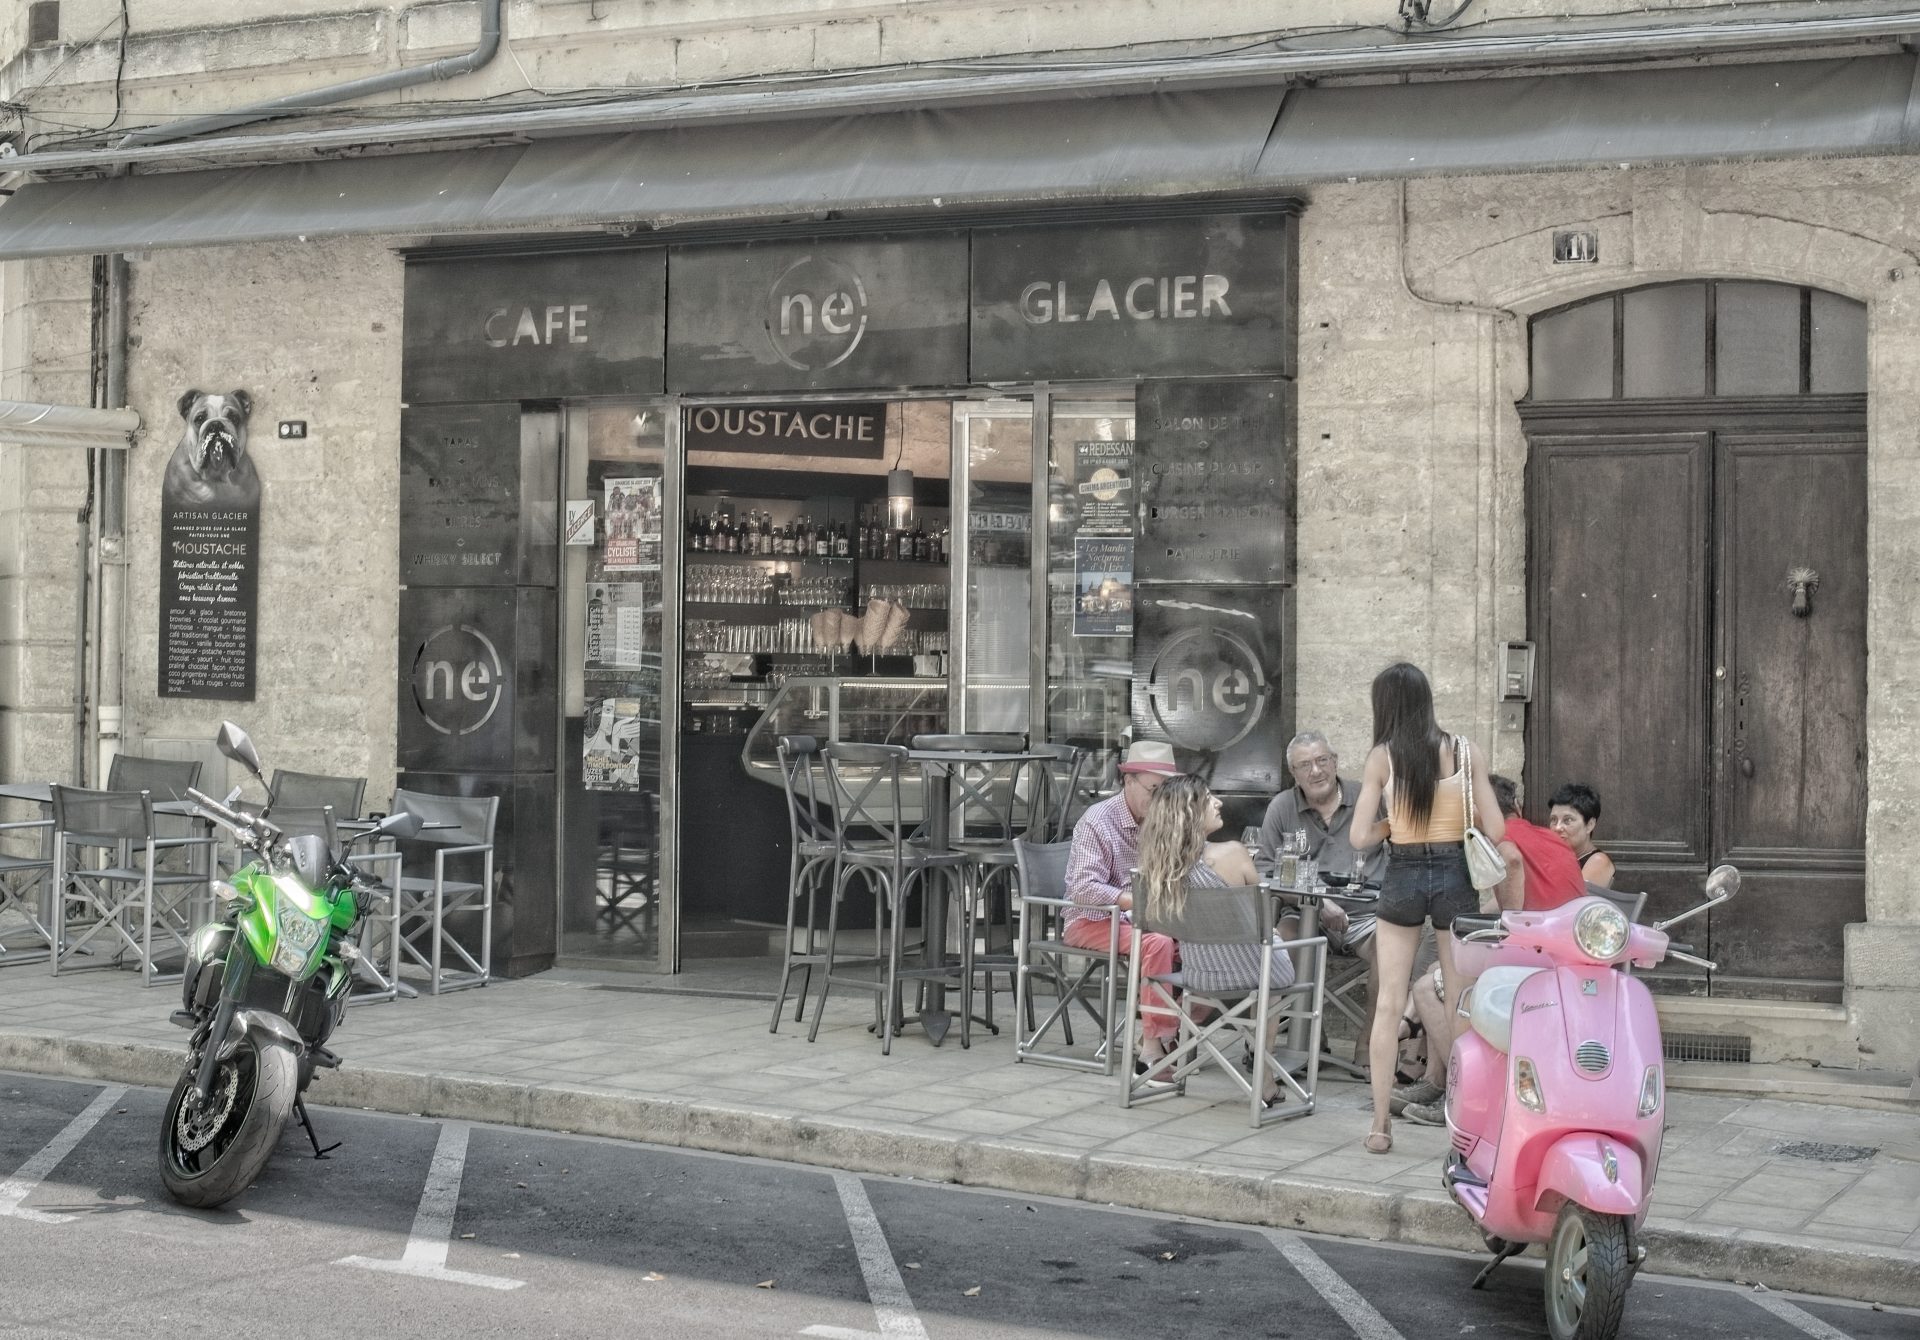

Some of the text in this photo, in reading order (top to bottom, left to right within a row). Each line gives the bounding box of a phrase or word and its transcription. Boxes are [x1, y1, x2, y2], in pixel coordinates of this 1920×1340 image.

[1020, 274, 1232, 324] GLACIER
[484, 304, 588, 348] CAFE
[1154, 417, 1203, 430] SALON
[1208, 416, 1228, 430] DE
[1089, 442, 1134, 456] REDESSAN
[1152, 462, 1205, 475] CUISINE
[1152, 506, 1205, 519] BURGER
[608, 546, 636, 557] CYCLISTE
[1086, 544, 1126, 553] Les Mardis
[413, 552, 502, 566] WHISKY SELECT
